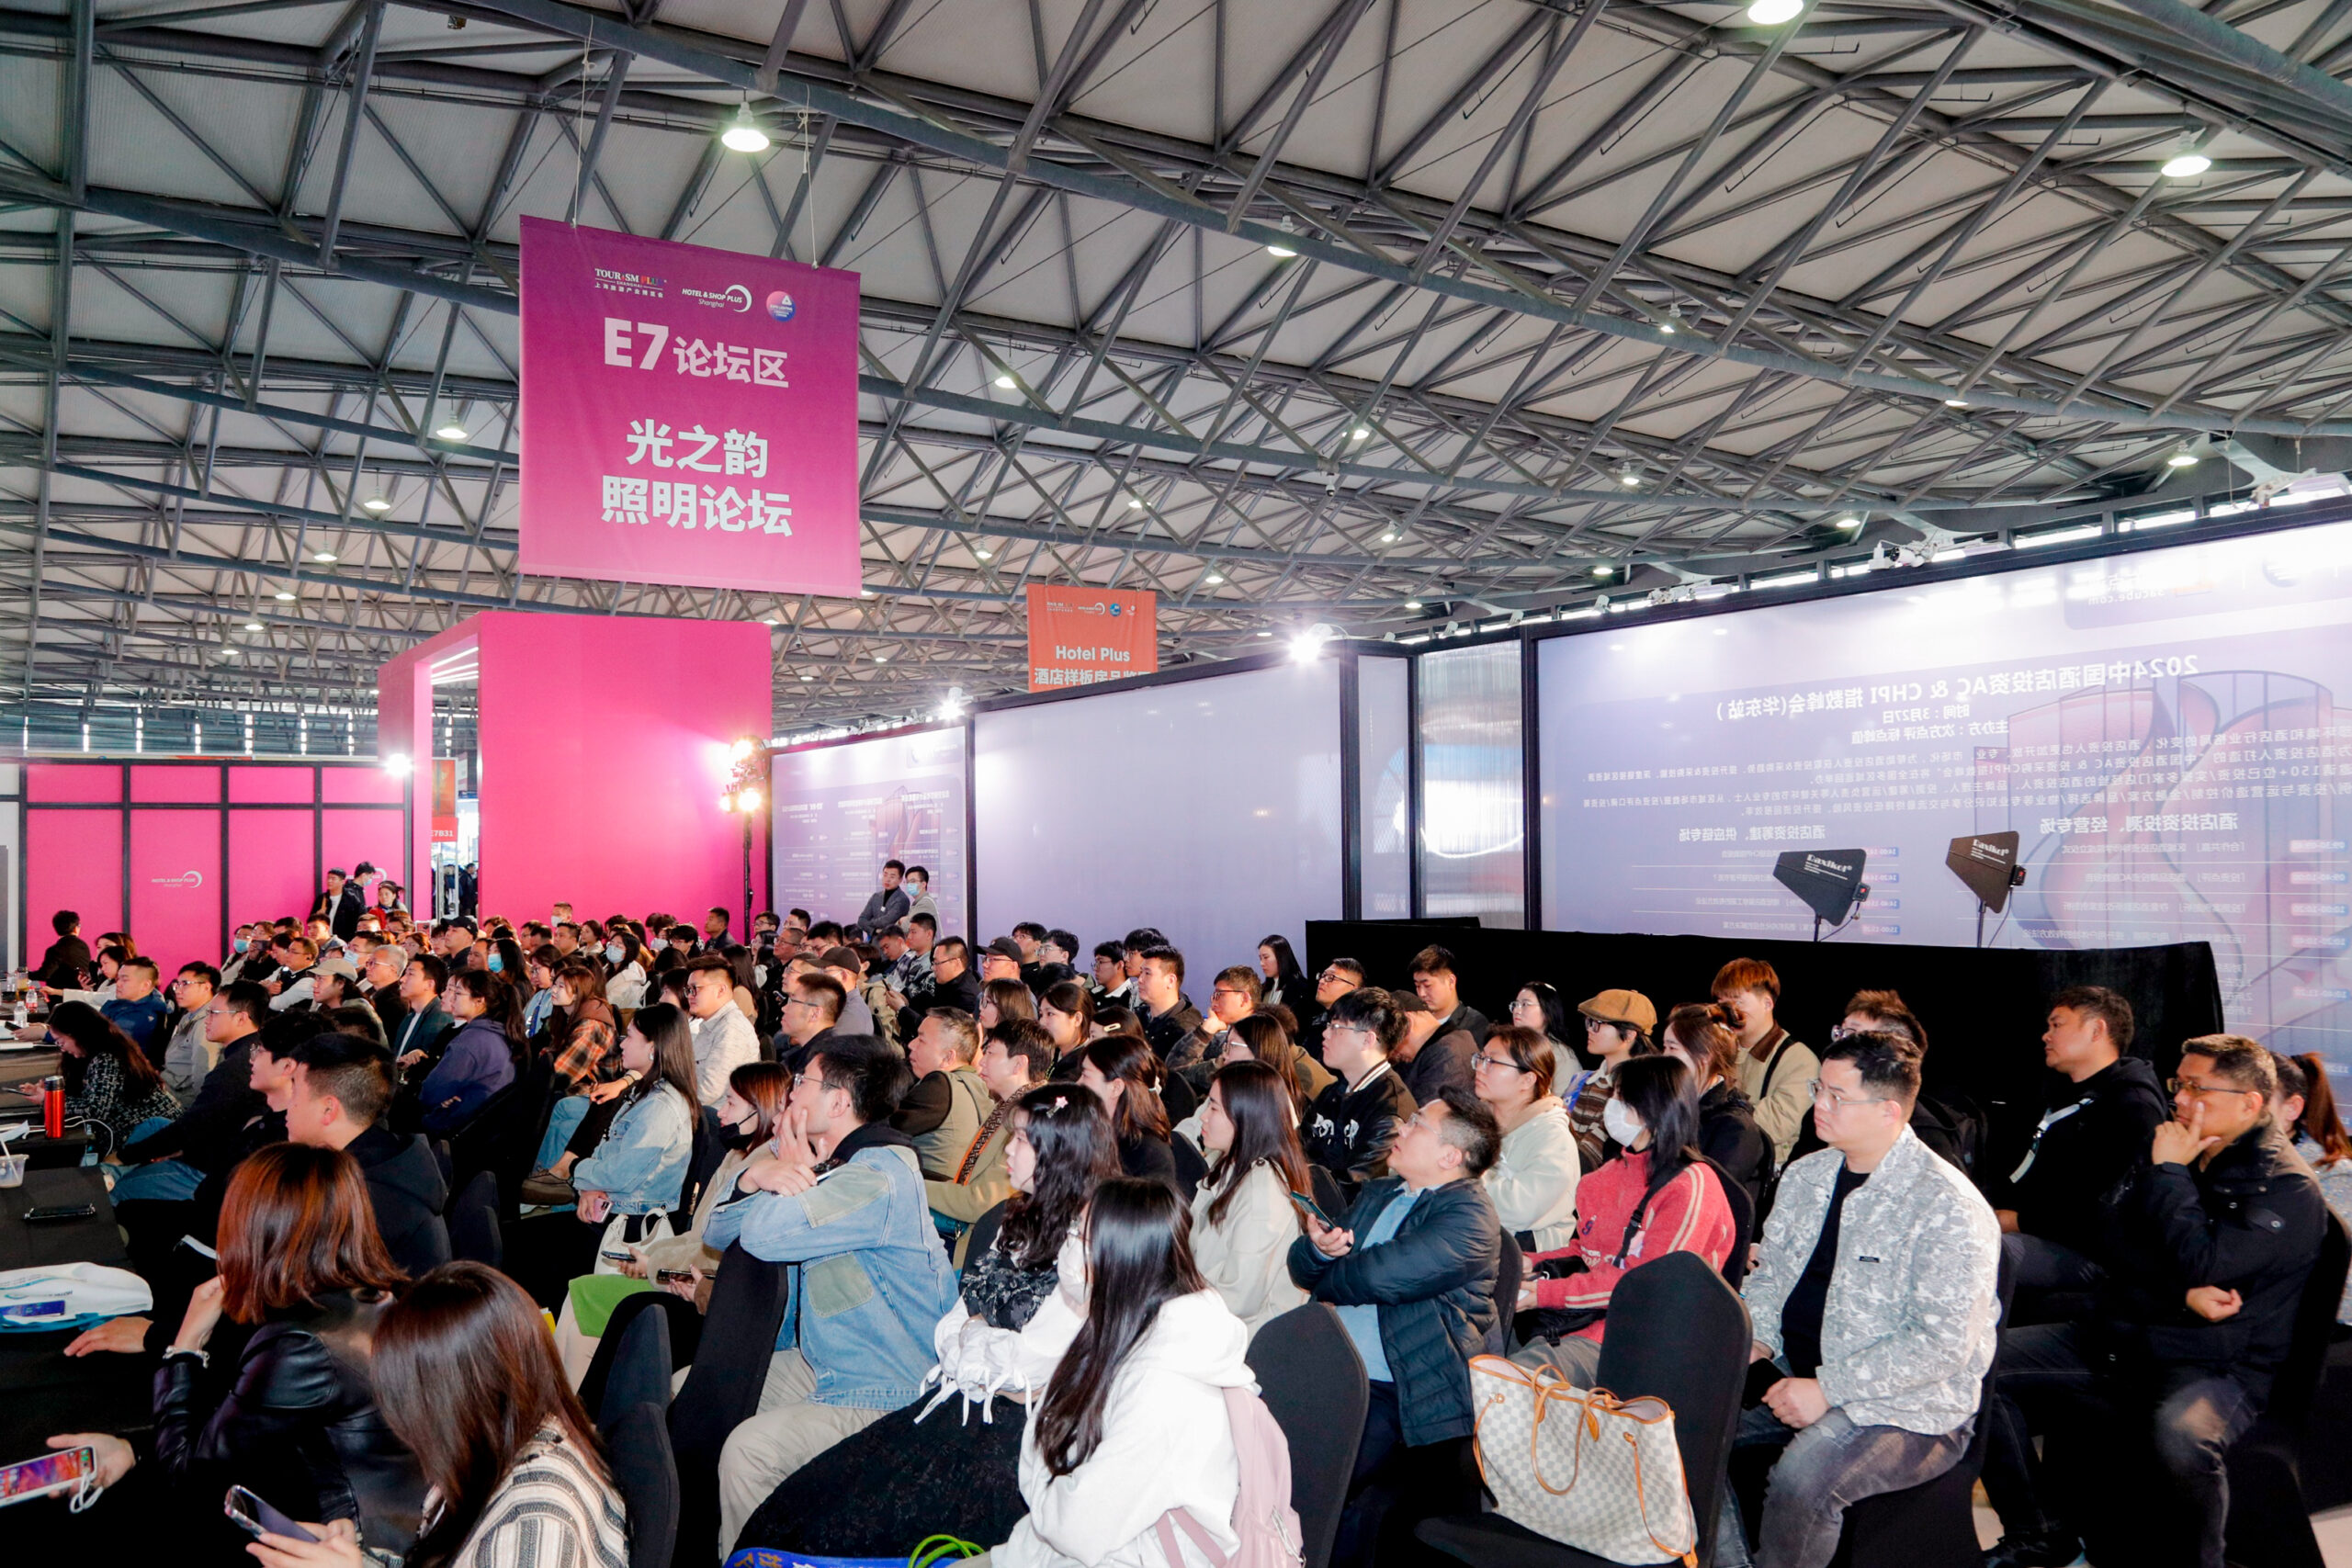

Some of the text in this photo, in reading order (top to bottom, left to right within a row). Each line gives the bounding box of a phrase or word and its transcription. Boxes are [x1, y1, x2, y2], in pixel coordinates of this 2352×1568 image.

[682, 288, 703, 298] HOTEL
[708, 291, 727, 301] SHOP
[727, 294, 742, 304] PLUS
[698, 299, 725, 308] Shanghai
[626, 418, 769, 478] 光之韵
[601, 475, 793, 536] 照明论坛
[1056, 645, 1131, 662] Hotel Plus
[1035, 667, 1151, 685] 酒店样板房品
